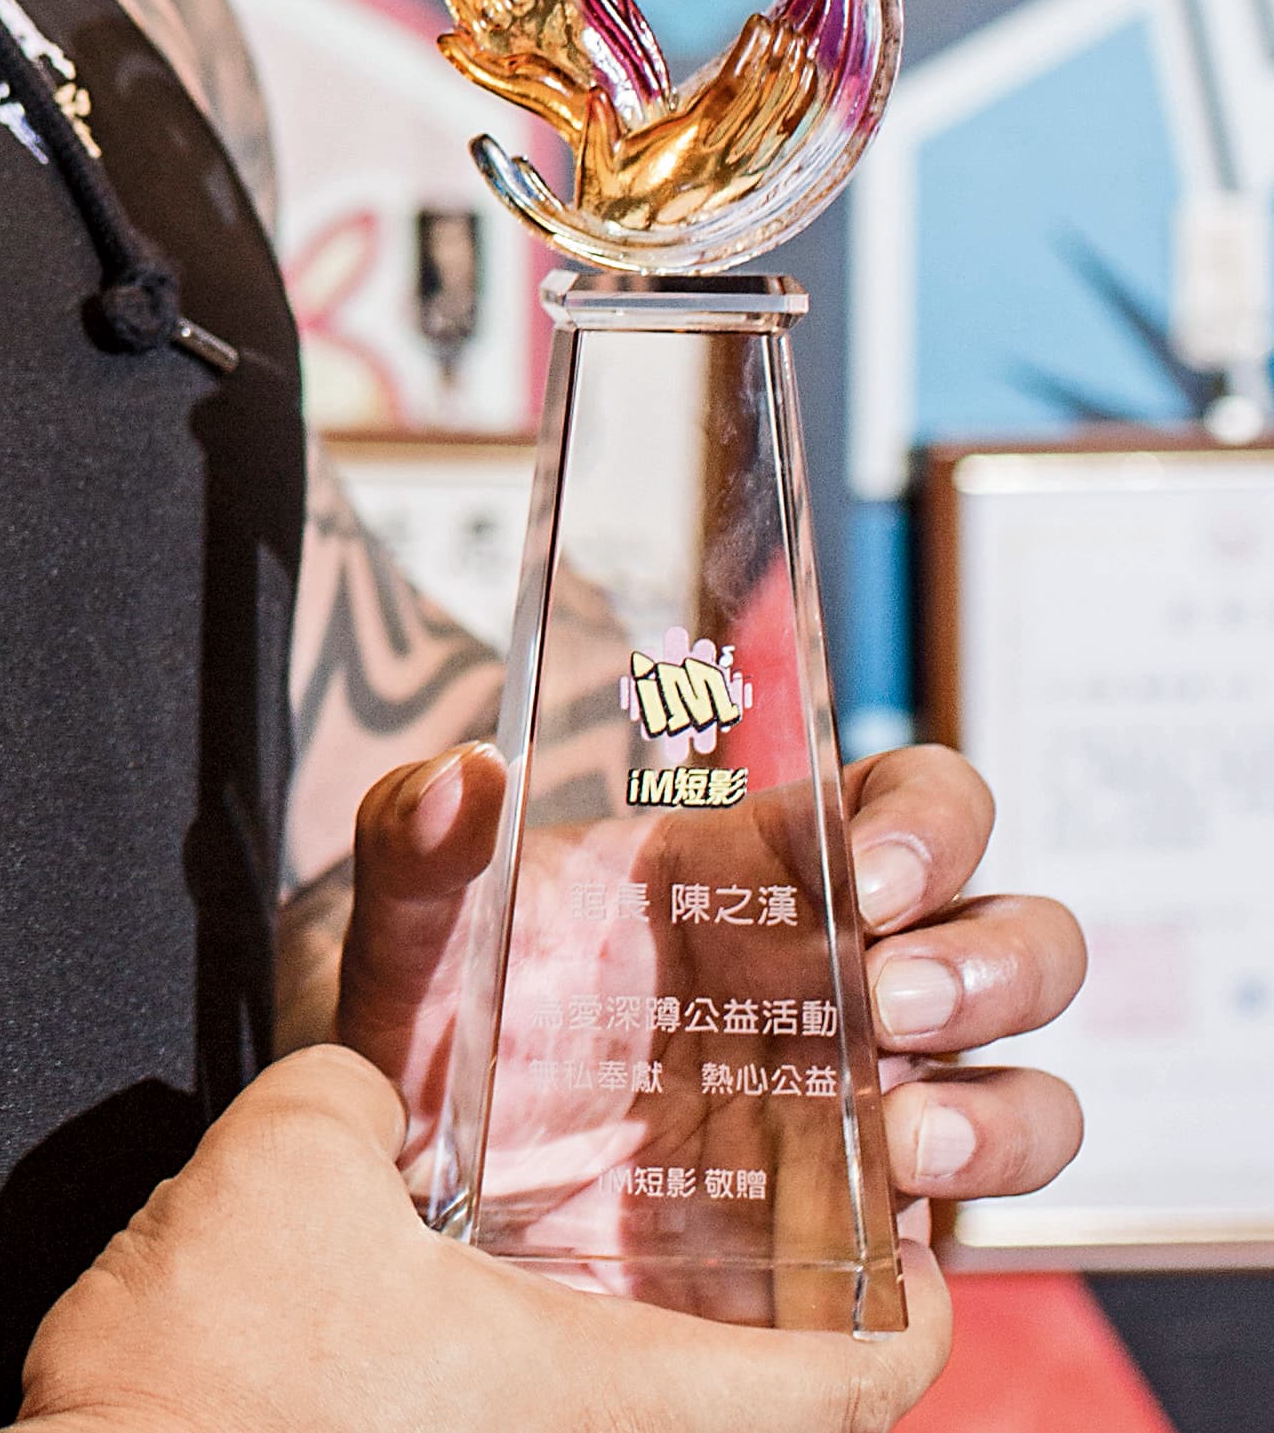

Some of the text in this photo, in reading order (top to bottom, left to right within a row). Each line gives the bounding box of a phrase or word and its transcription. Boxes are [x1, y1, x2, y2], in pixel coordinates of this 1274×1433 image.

[628, 766, 748, 808] iM短影
[670, 883, 798, 926] 陳之漢
[701, 1062, 838, 1097] 熱心公益
[704, 1168, 767, 1200] 敬贈
